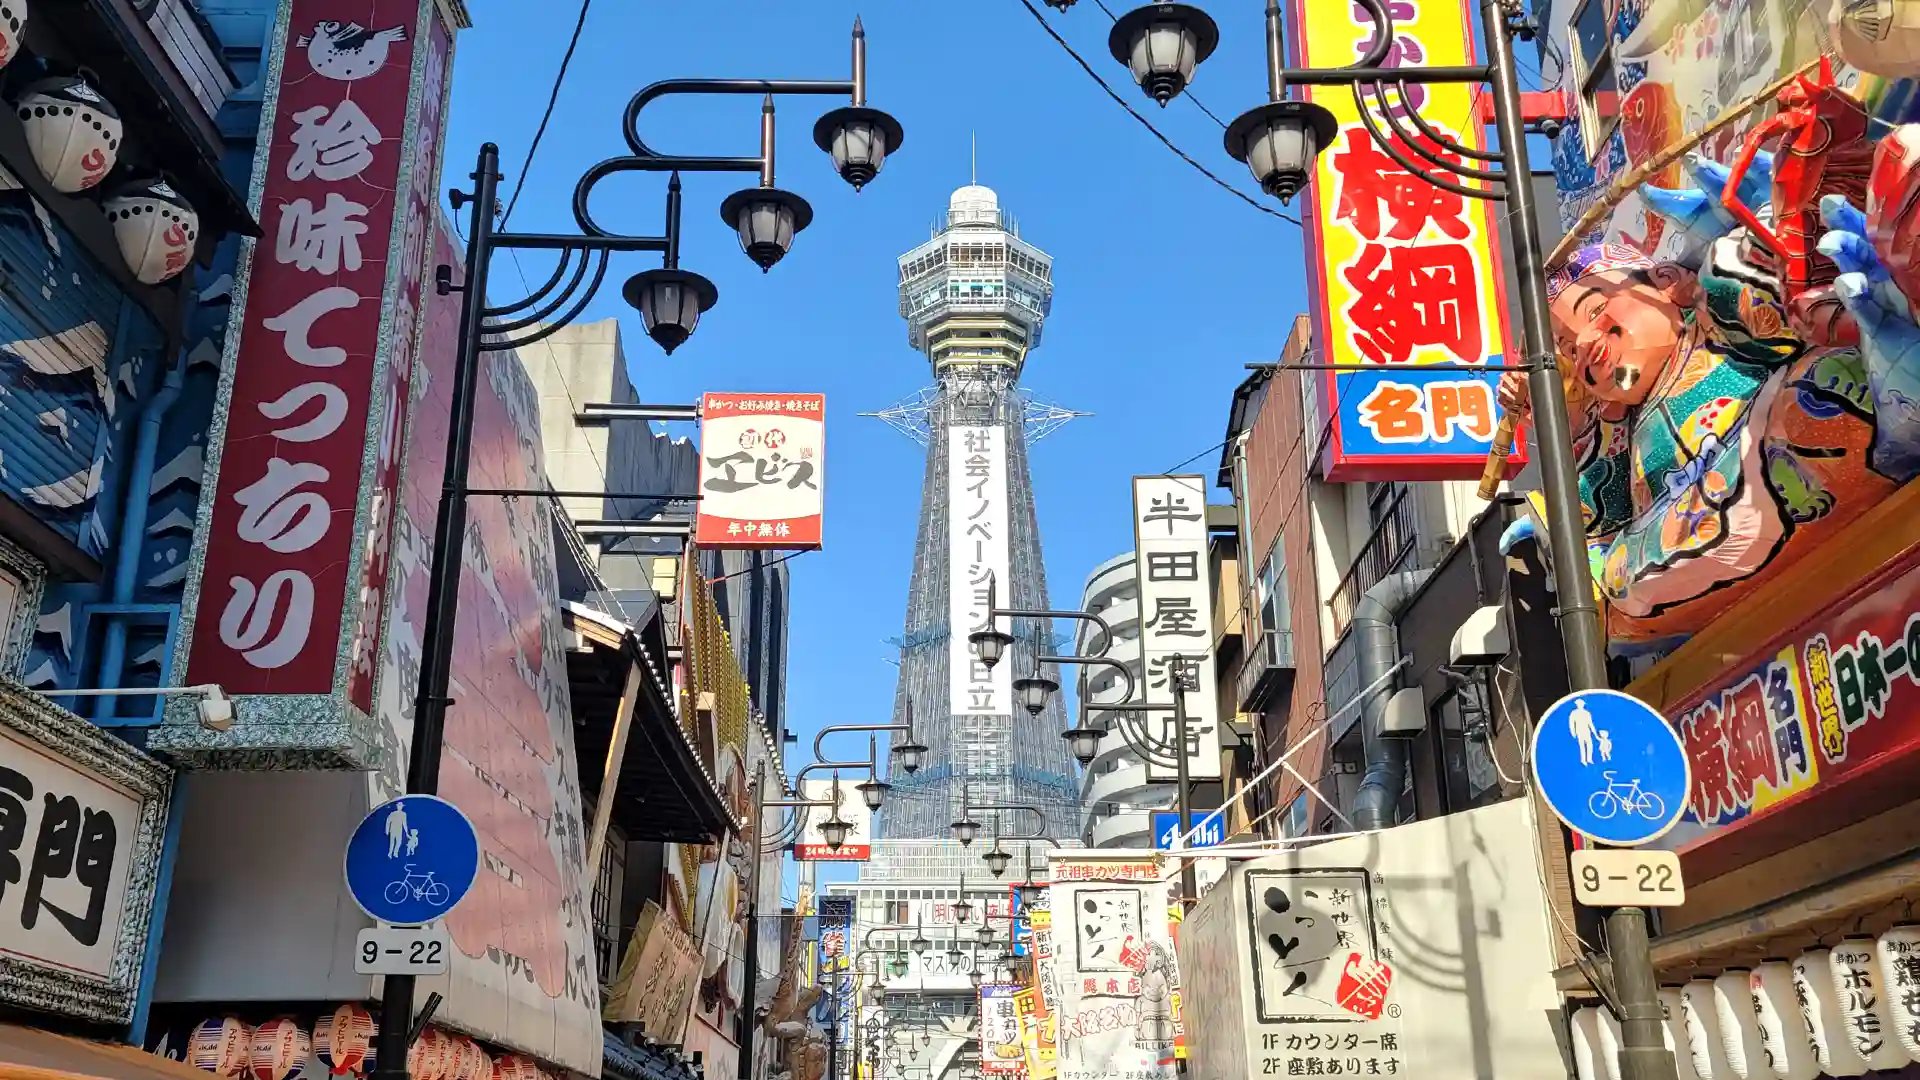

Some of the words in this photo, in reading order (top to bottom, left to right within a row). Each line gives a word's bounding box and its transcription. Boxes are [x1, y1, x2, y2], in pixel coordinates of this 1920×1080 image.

[1353, 0, 1425, 118] かつ
[1334, 126, 1483, 363] 横綱
[219, 100, 382, 669] 珍味てっちり
[1363, 386, 1494, 439] 名門
[726, 522, 792, 537] 年中無休
[964, 430, 996, 711] 社会イノベーション日立
[1143, 492, 1214, 757] 半田屋酒店
[1768, 667, 1807, 782] 名門
[1162, 822, 1219, 848] Aahi
[1056, 864, 1160, 879] 元祖串カツ専門店
[1836, 953, 1871, 965] 串かつ
[1262, 1033, 1279, 1051] 1F
[1286, 1033, 1399, 1051] カウンター席
[1843, 969, 1885, 1056] ホルモン
[1262, 1058, 1281, 1076] 2F
[1287, 1057, 1400, 1076] 座敷あります
